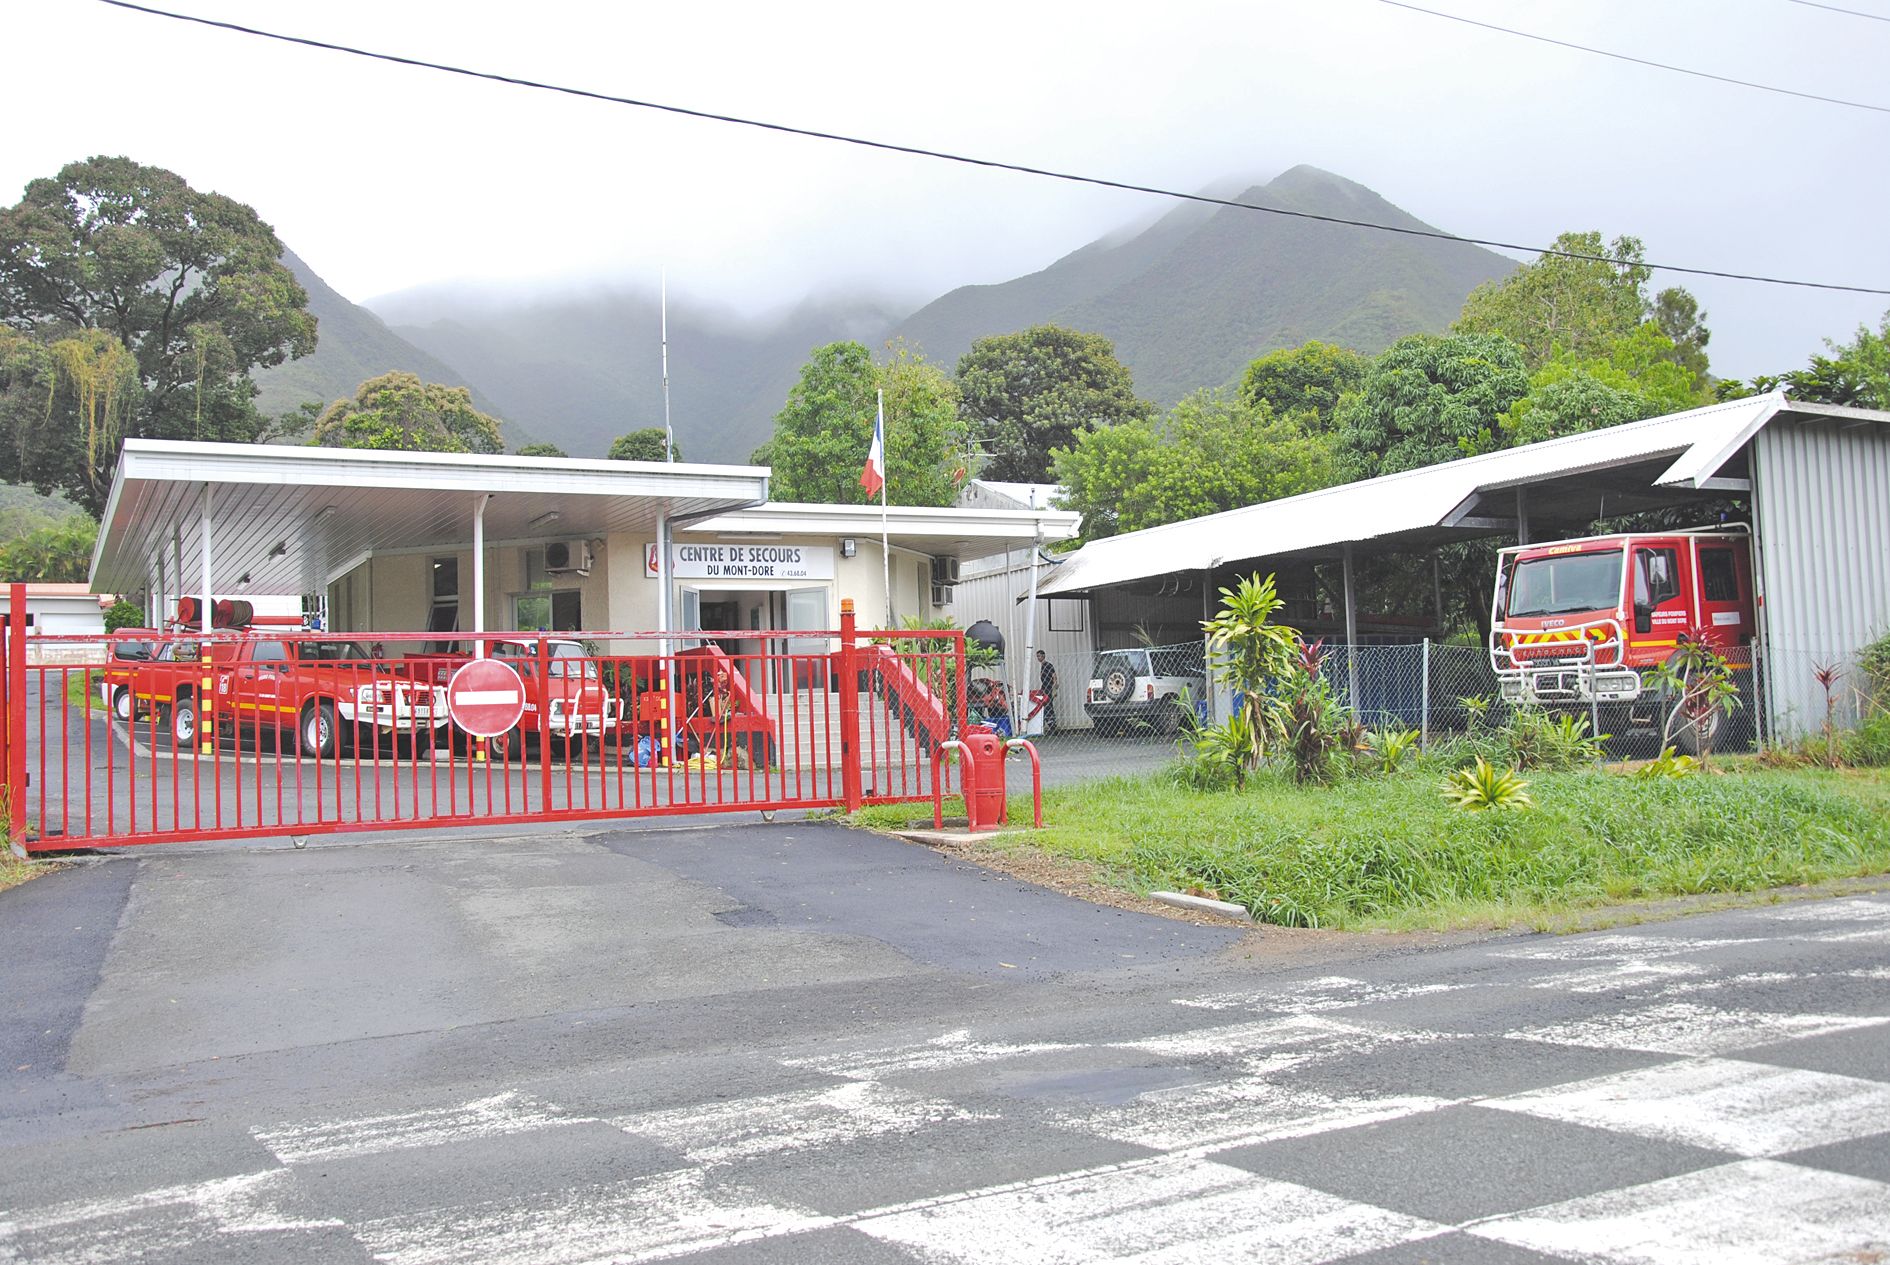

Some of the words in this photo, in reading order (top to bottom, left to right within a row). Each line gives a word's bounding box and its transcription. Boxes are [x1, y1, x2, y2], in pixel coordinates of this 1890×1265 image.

[679, 546, 724, 563] CENTRE
[730, 547, 744, 563] DE
[749, 547, 801, 563] SECOURS
[707, 565, 719, 575] DU
[723, 565, 774, 576] MONT-DORE
[1541, 619, 1565, 628] IVECO
